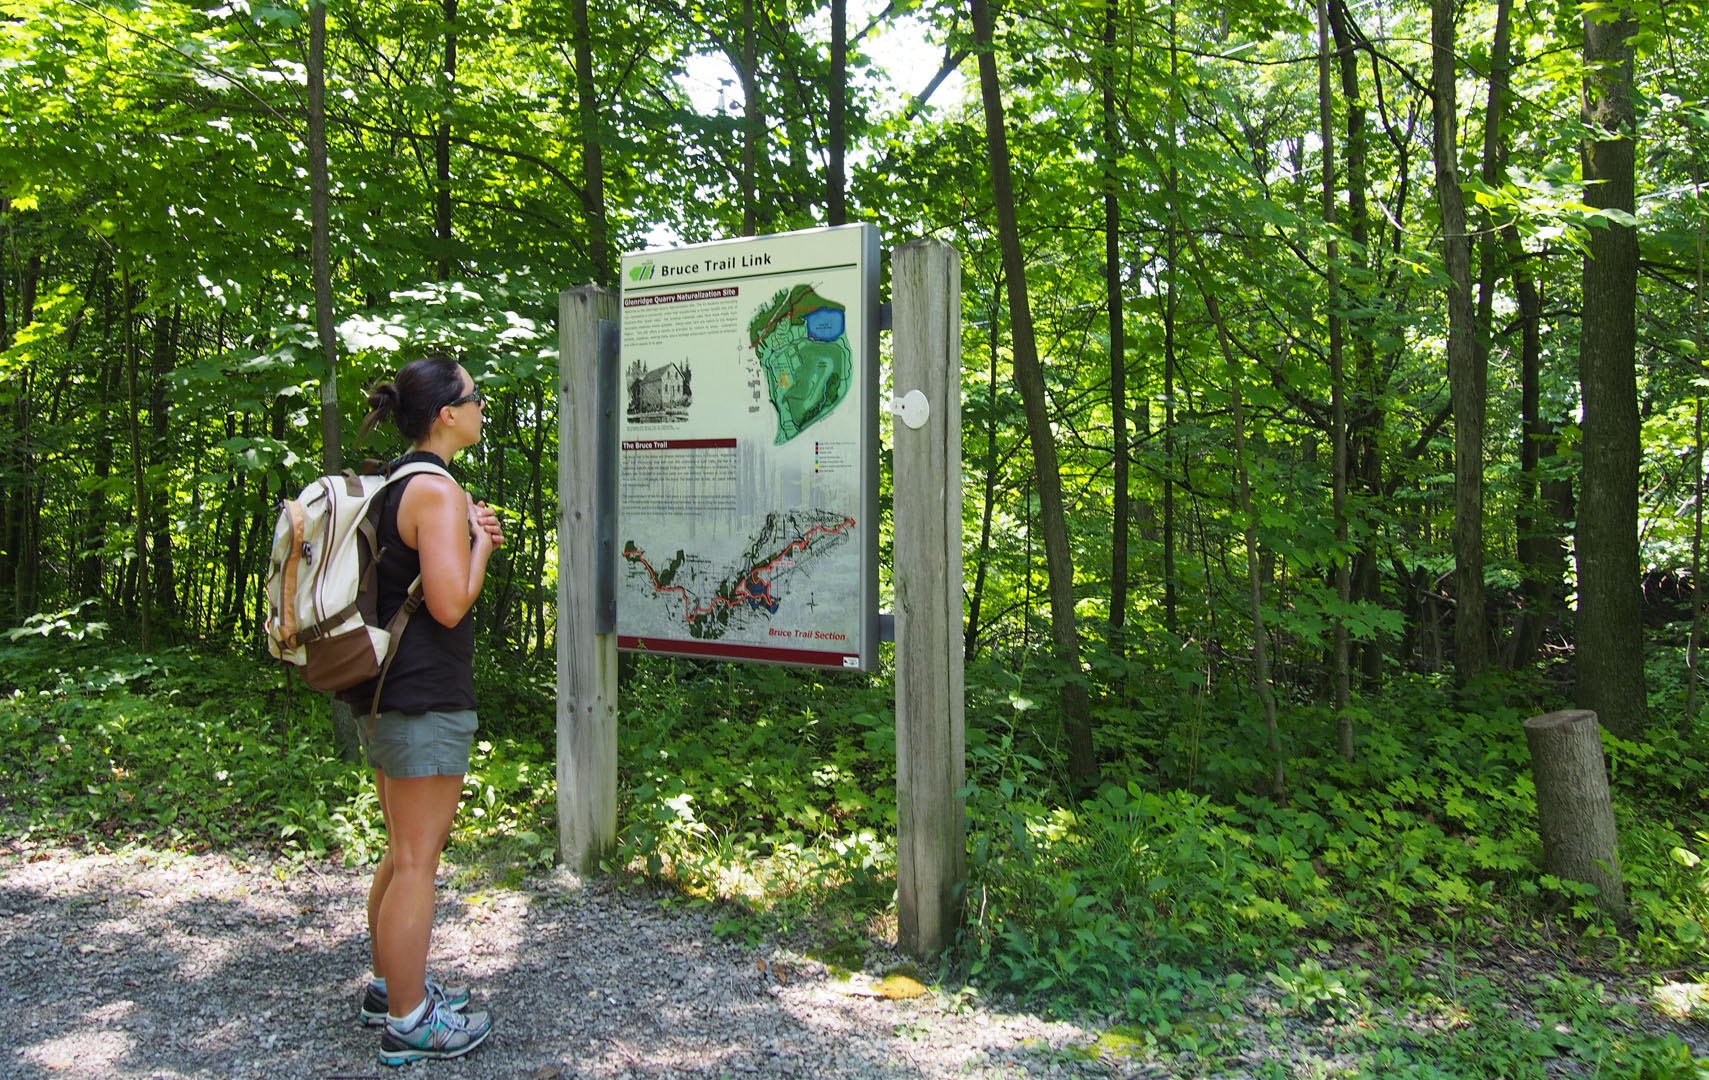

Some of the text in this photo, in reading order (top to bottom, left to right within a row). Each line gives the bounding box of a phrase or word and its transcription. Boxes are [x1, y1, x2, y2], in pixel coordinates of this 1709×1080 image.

[661, 253, 772, 277] Bruce Trail Link
[624, 288, 736, 306] Glenridge Quarry Naturalization Site
[768, 627, 846, 640] Bruce Trail Section
